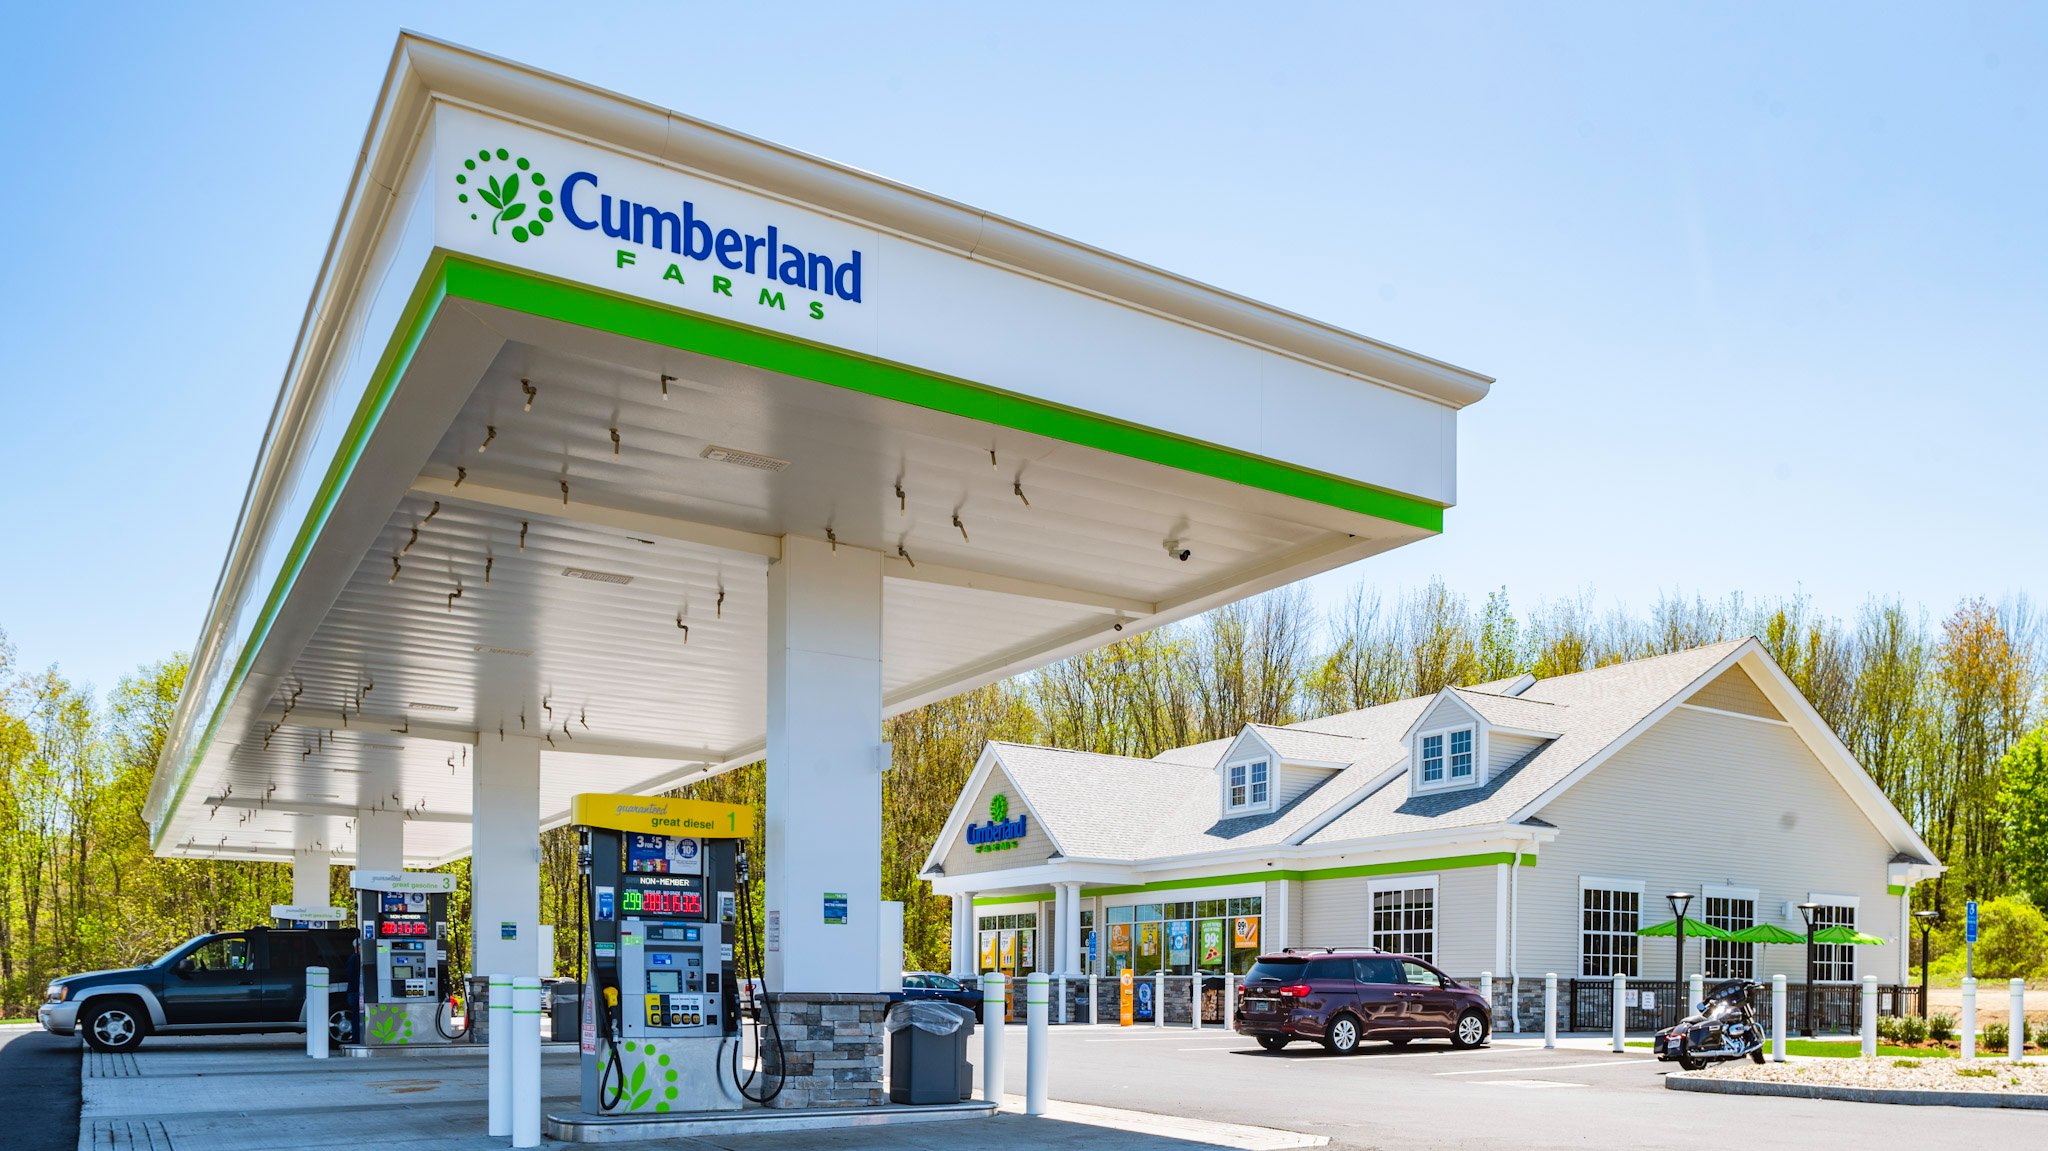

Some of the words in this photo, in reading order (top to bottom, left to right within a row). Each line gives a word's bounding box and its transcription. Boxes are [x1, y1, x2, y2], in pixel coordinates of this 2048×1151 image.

[560, 171, 862, 303] Cumberland
[617, 250, 825, 320] FARMS
[616, 803, 669, 816] guaranteed
[651, 817, 681, 828] great
[683, 818, 714, 830] diesel
[727, 811, 735, 832] 1
[966, 814, 1026, 845] Cumberland
[636, 835, 645, 848] 3
[975, 840, 1018, 853] FARMS
[391, 881, 410, 889] great
[410, 882, 438, 890] gasoline
[442, 877, 450, 890] 3
[640, 877, 690, 886] NON-MEMBER
[335, 910, 341, 919] 5
[1204, 933, 1219, 949] 99¢
